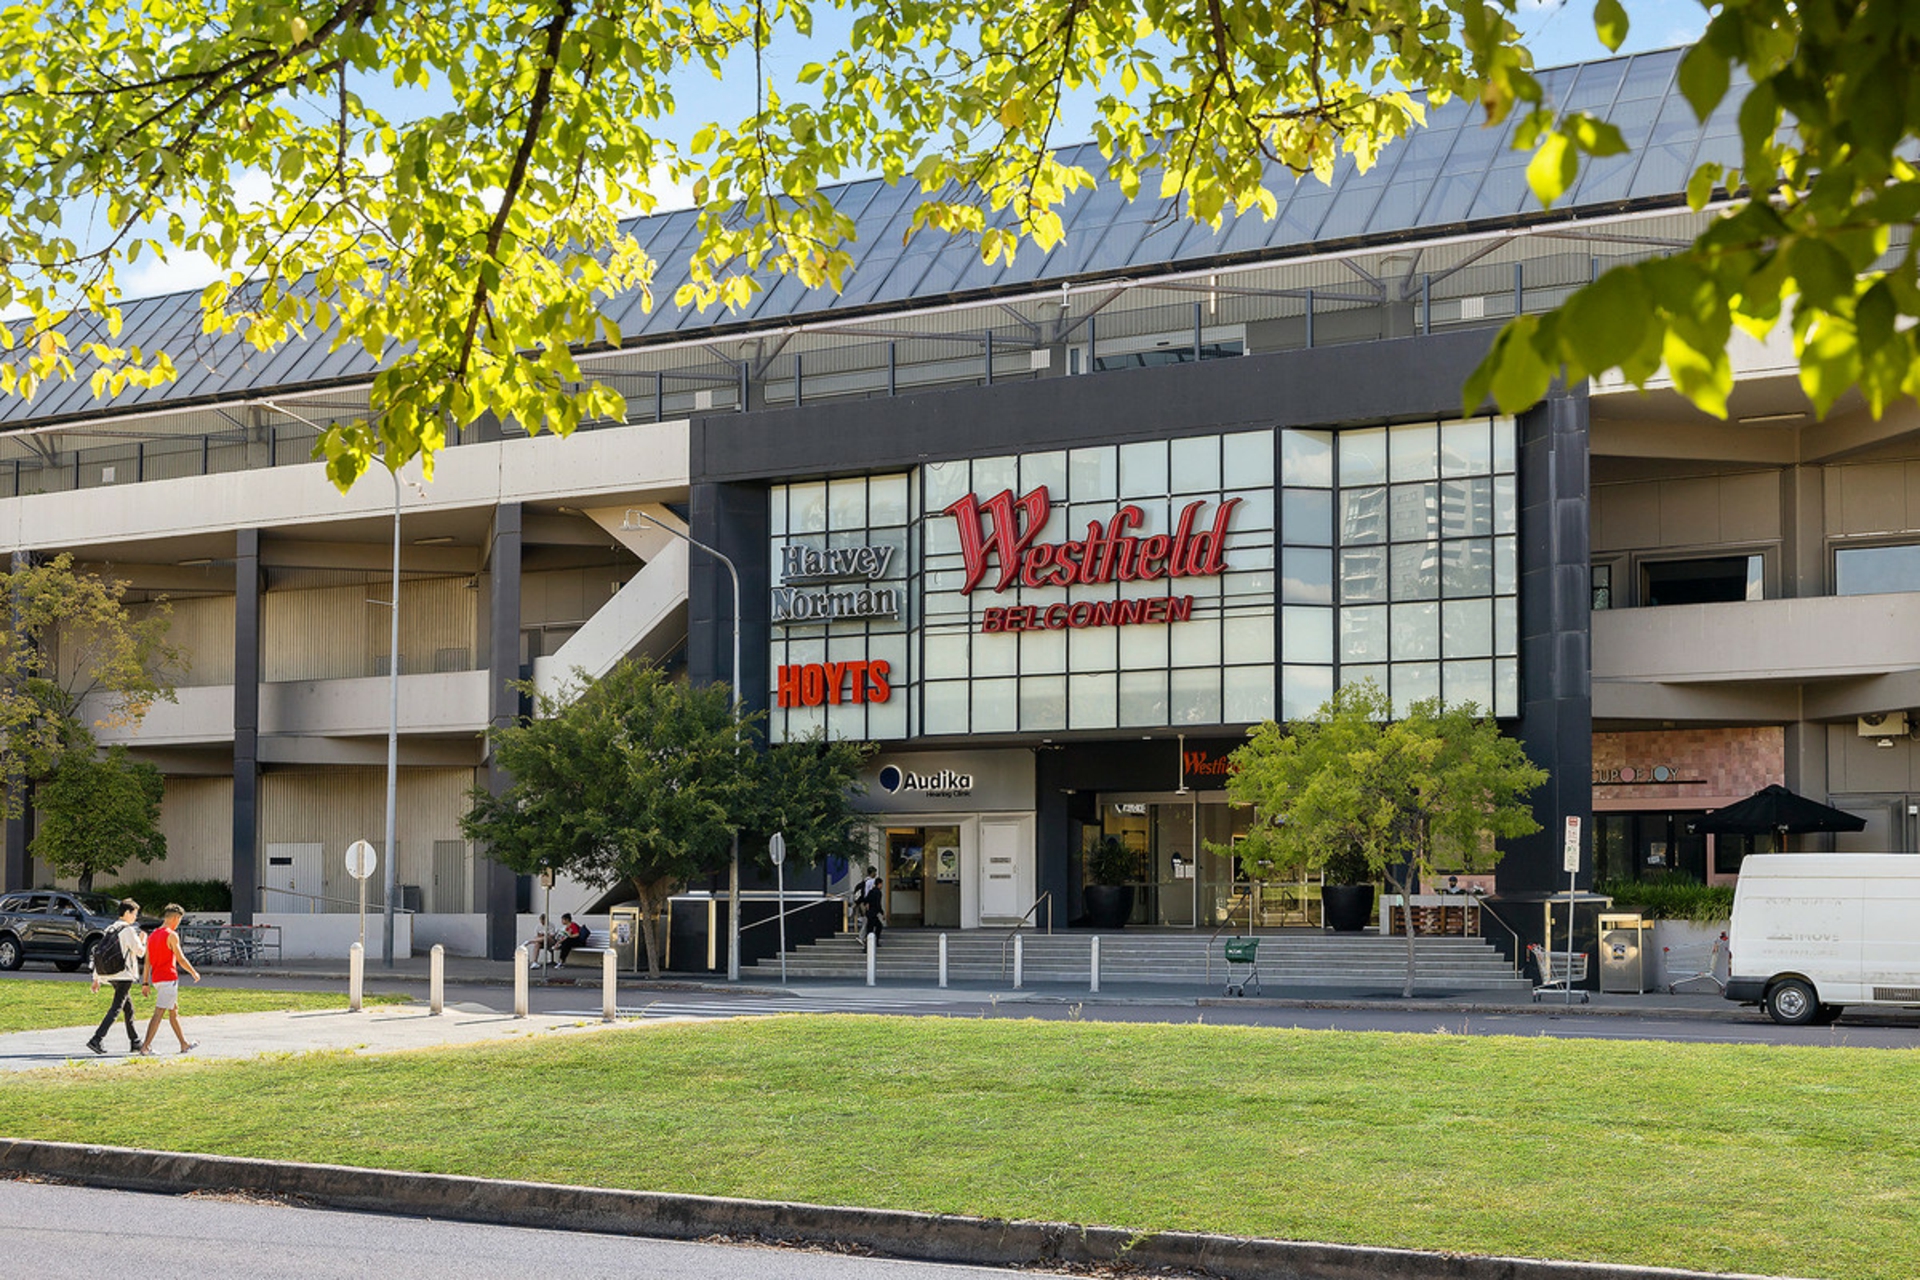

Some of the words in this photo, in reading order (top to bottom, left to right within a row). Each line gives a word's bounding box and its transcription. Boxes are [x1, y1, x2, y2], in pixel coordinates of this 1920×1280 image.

[943, 485, 1243, 595] Westfield
[780, 544, 895, 579] Harvey
[771, 586, 898, 620] Norman
[982, 595, 1194, 633] BELCONNEN
[777, 659, 891, 708] HOYTS
[904, 769, 973, 791] Audika
[1648, 765, 1680, 783] JOY
